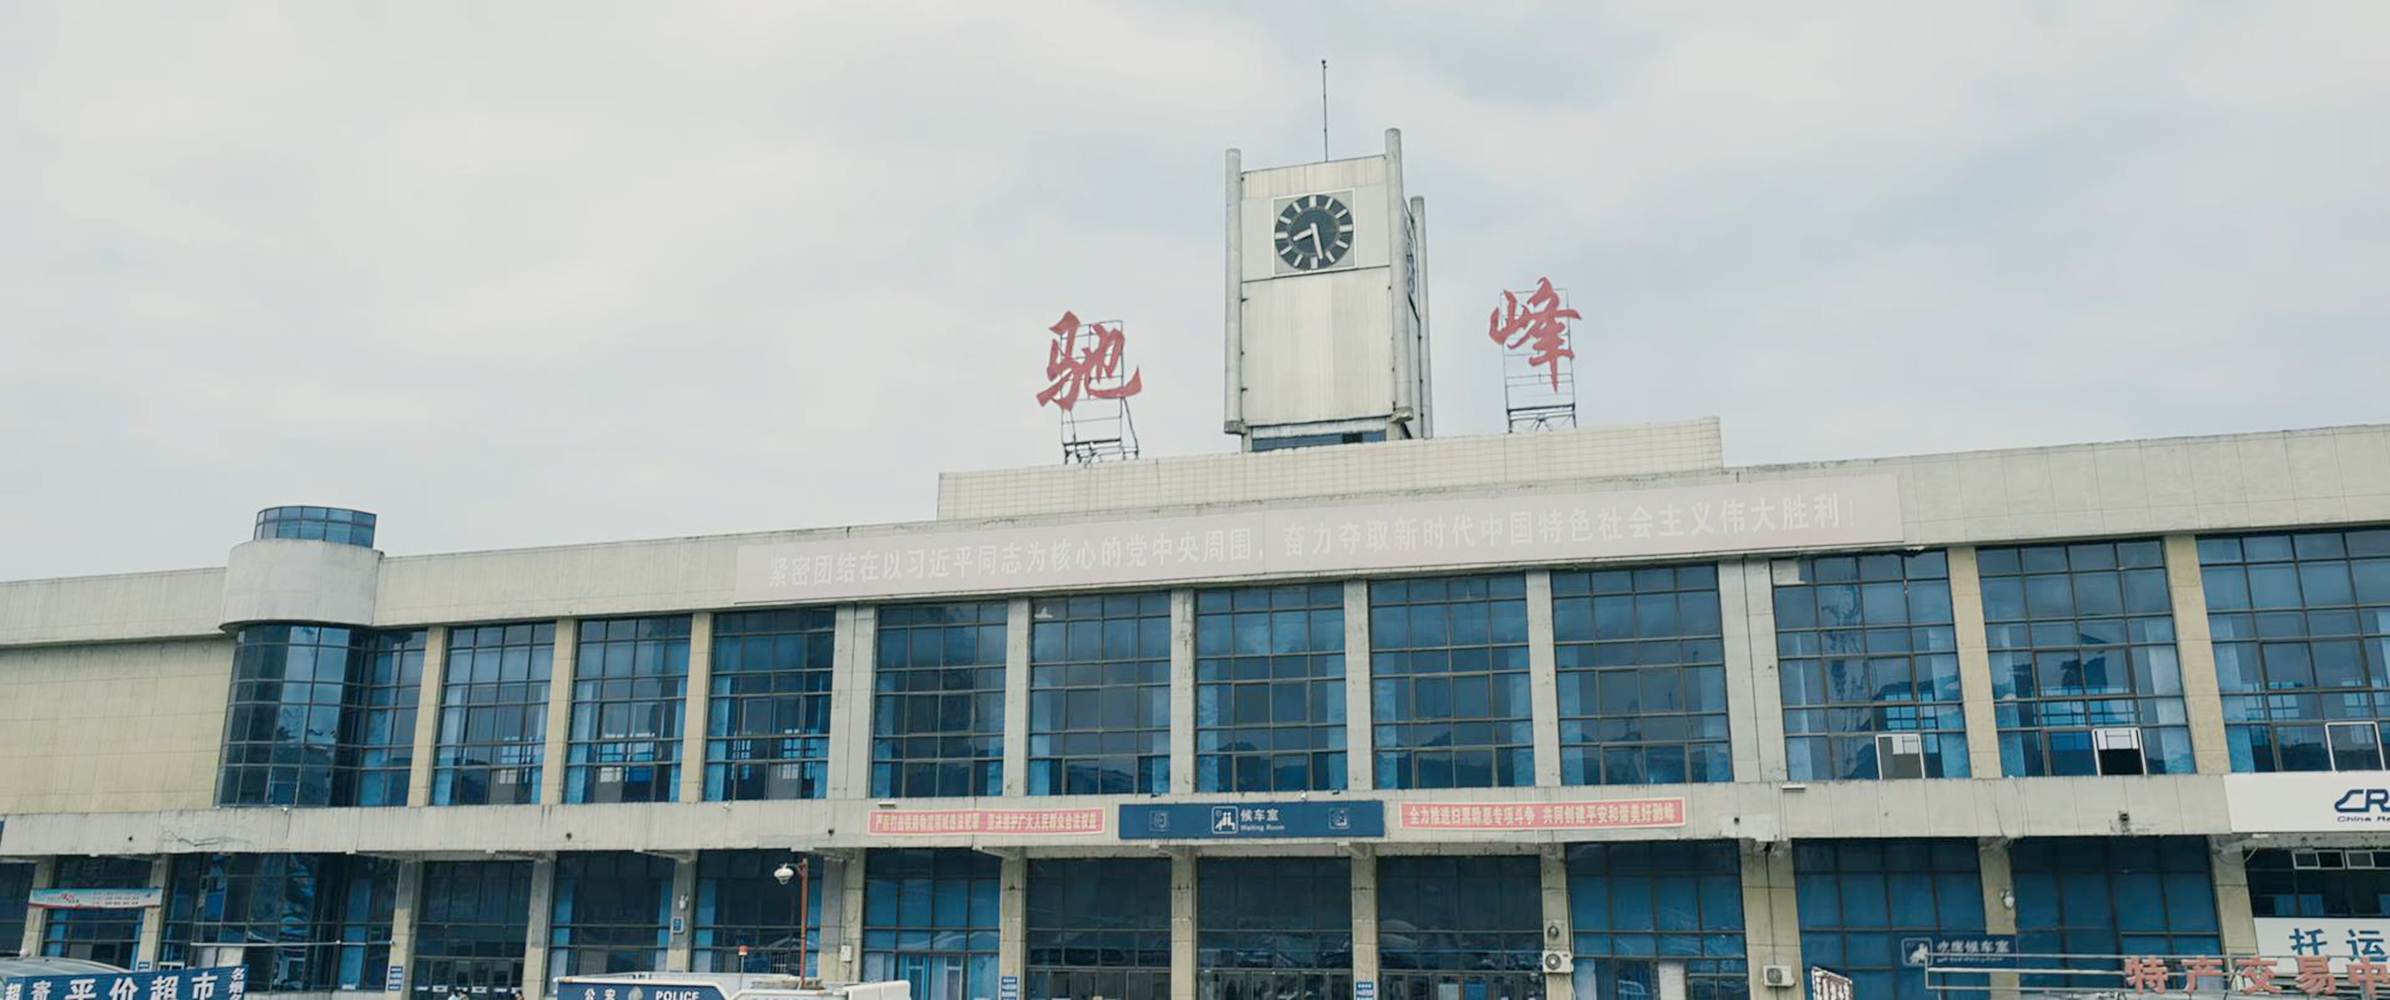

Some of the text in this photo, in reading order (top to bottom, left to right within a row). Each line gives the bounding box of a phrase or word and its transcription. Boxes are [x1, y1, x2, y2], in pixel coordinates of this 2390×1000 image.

[1240, 808, 1280, 822] 候车室
[1240, 824, 1285, 833] Waiting Room
[2289, 928, 2386, 962] 托运
[2124, 954, 2390, 995] 特产交易中
[584, 988, 616, 1000] 公安
[655, 990, 700, 1000] POLICE
